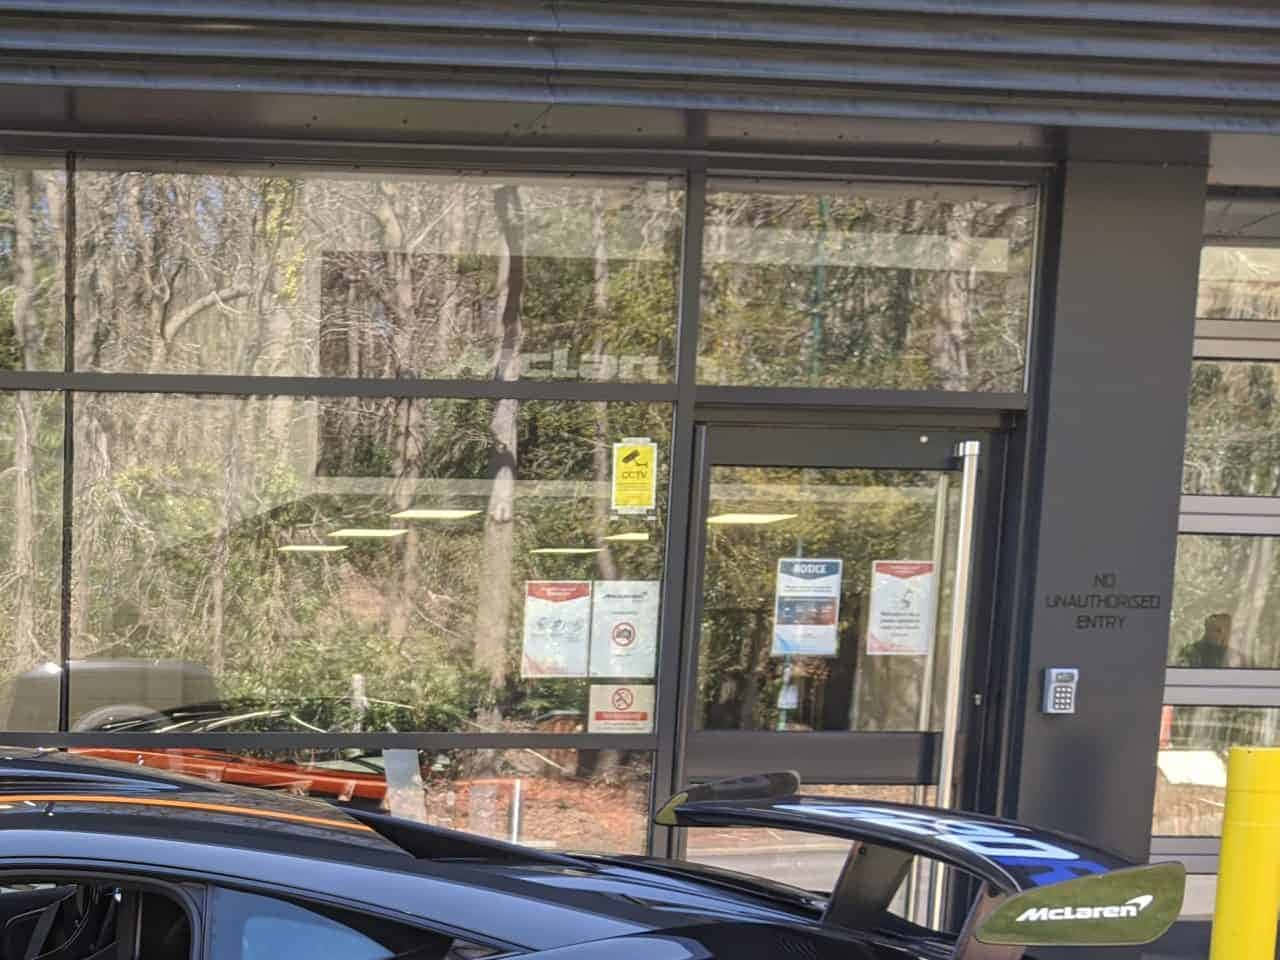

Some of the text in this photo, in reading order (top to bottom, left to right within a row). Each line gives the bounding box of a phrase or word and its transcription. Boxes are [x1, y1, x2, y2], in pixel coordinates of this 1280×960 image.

[622, 471, 648, 480] CCTV
[1094, 573, 1116, 588] NO
[1046, 594, 1161, 609] UNAUTHORISED
[1076, 615, 1127, 630] ENTRY
[1016, 904, 1138, 922] McLaren
